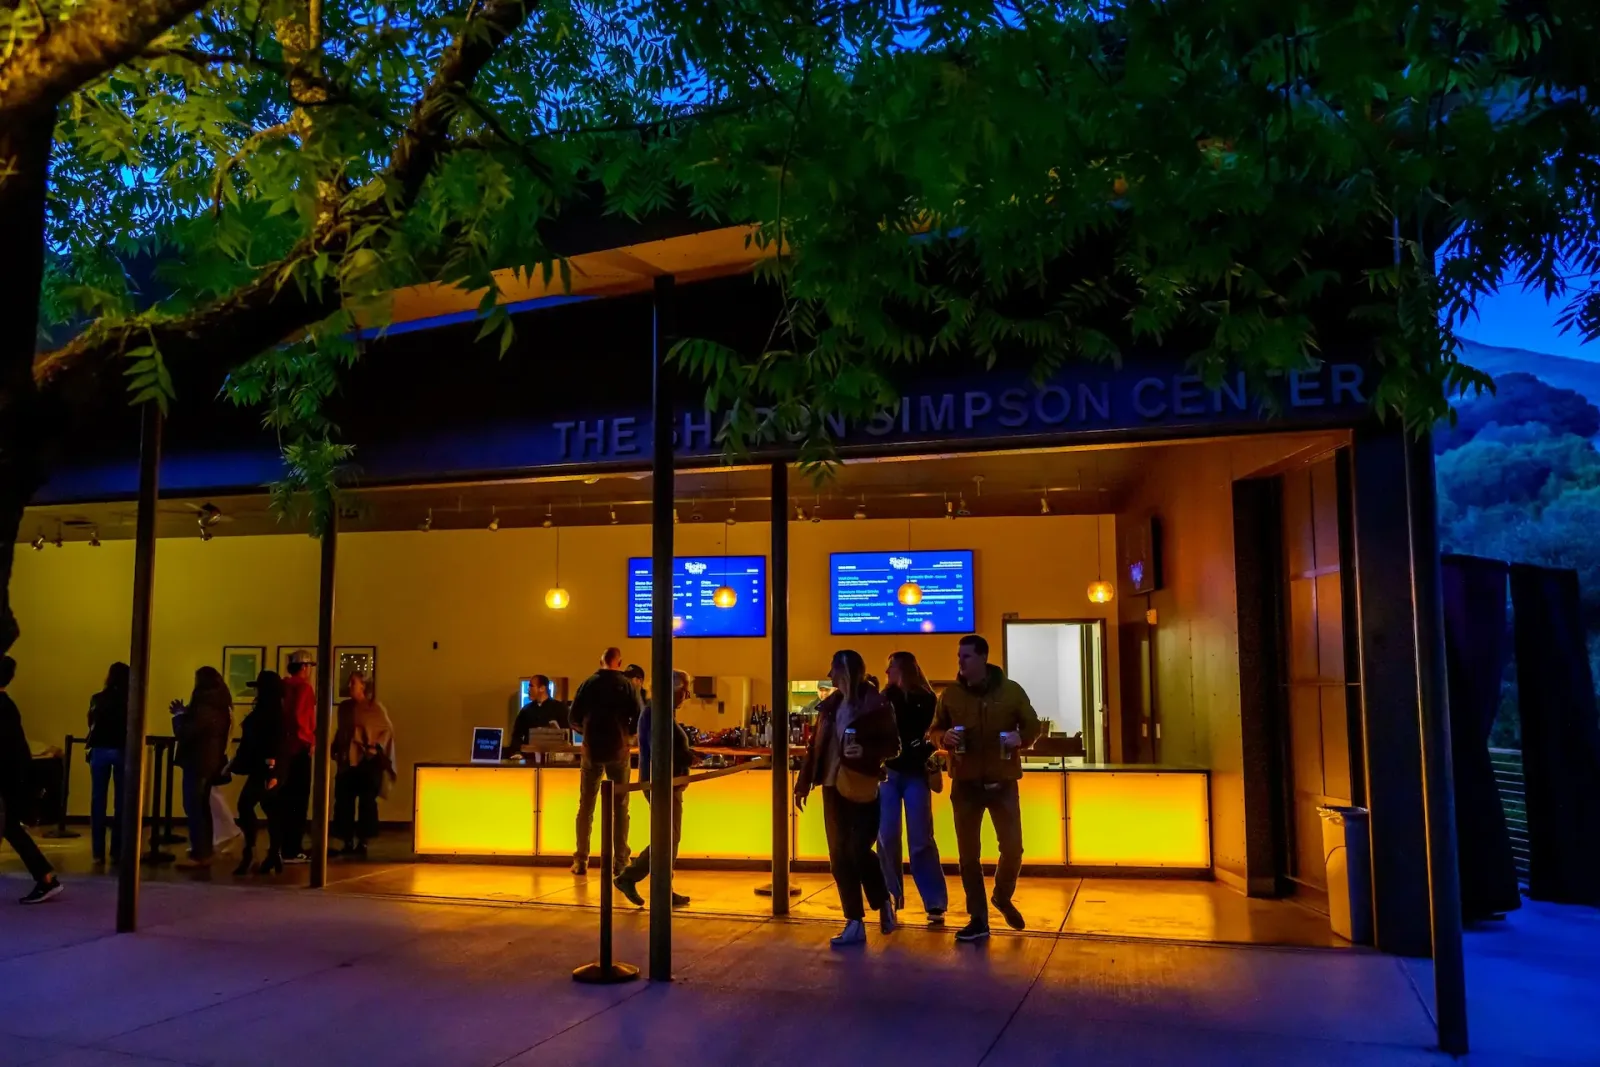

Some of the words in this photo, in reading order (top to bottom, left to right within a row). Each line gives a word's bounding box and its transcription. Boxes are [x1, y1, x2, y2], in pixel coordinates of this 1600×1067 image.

[553, 416, 636, 456] THE
[651, 402, 847, 450] HRON
[865, 382, 1110, 437] SIMPSON
[1131, 363, 1370, 418] CENER
